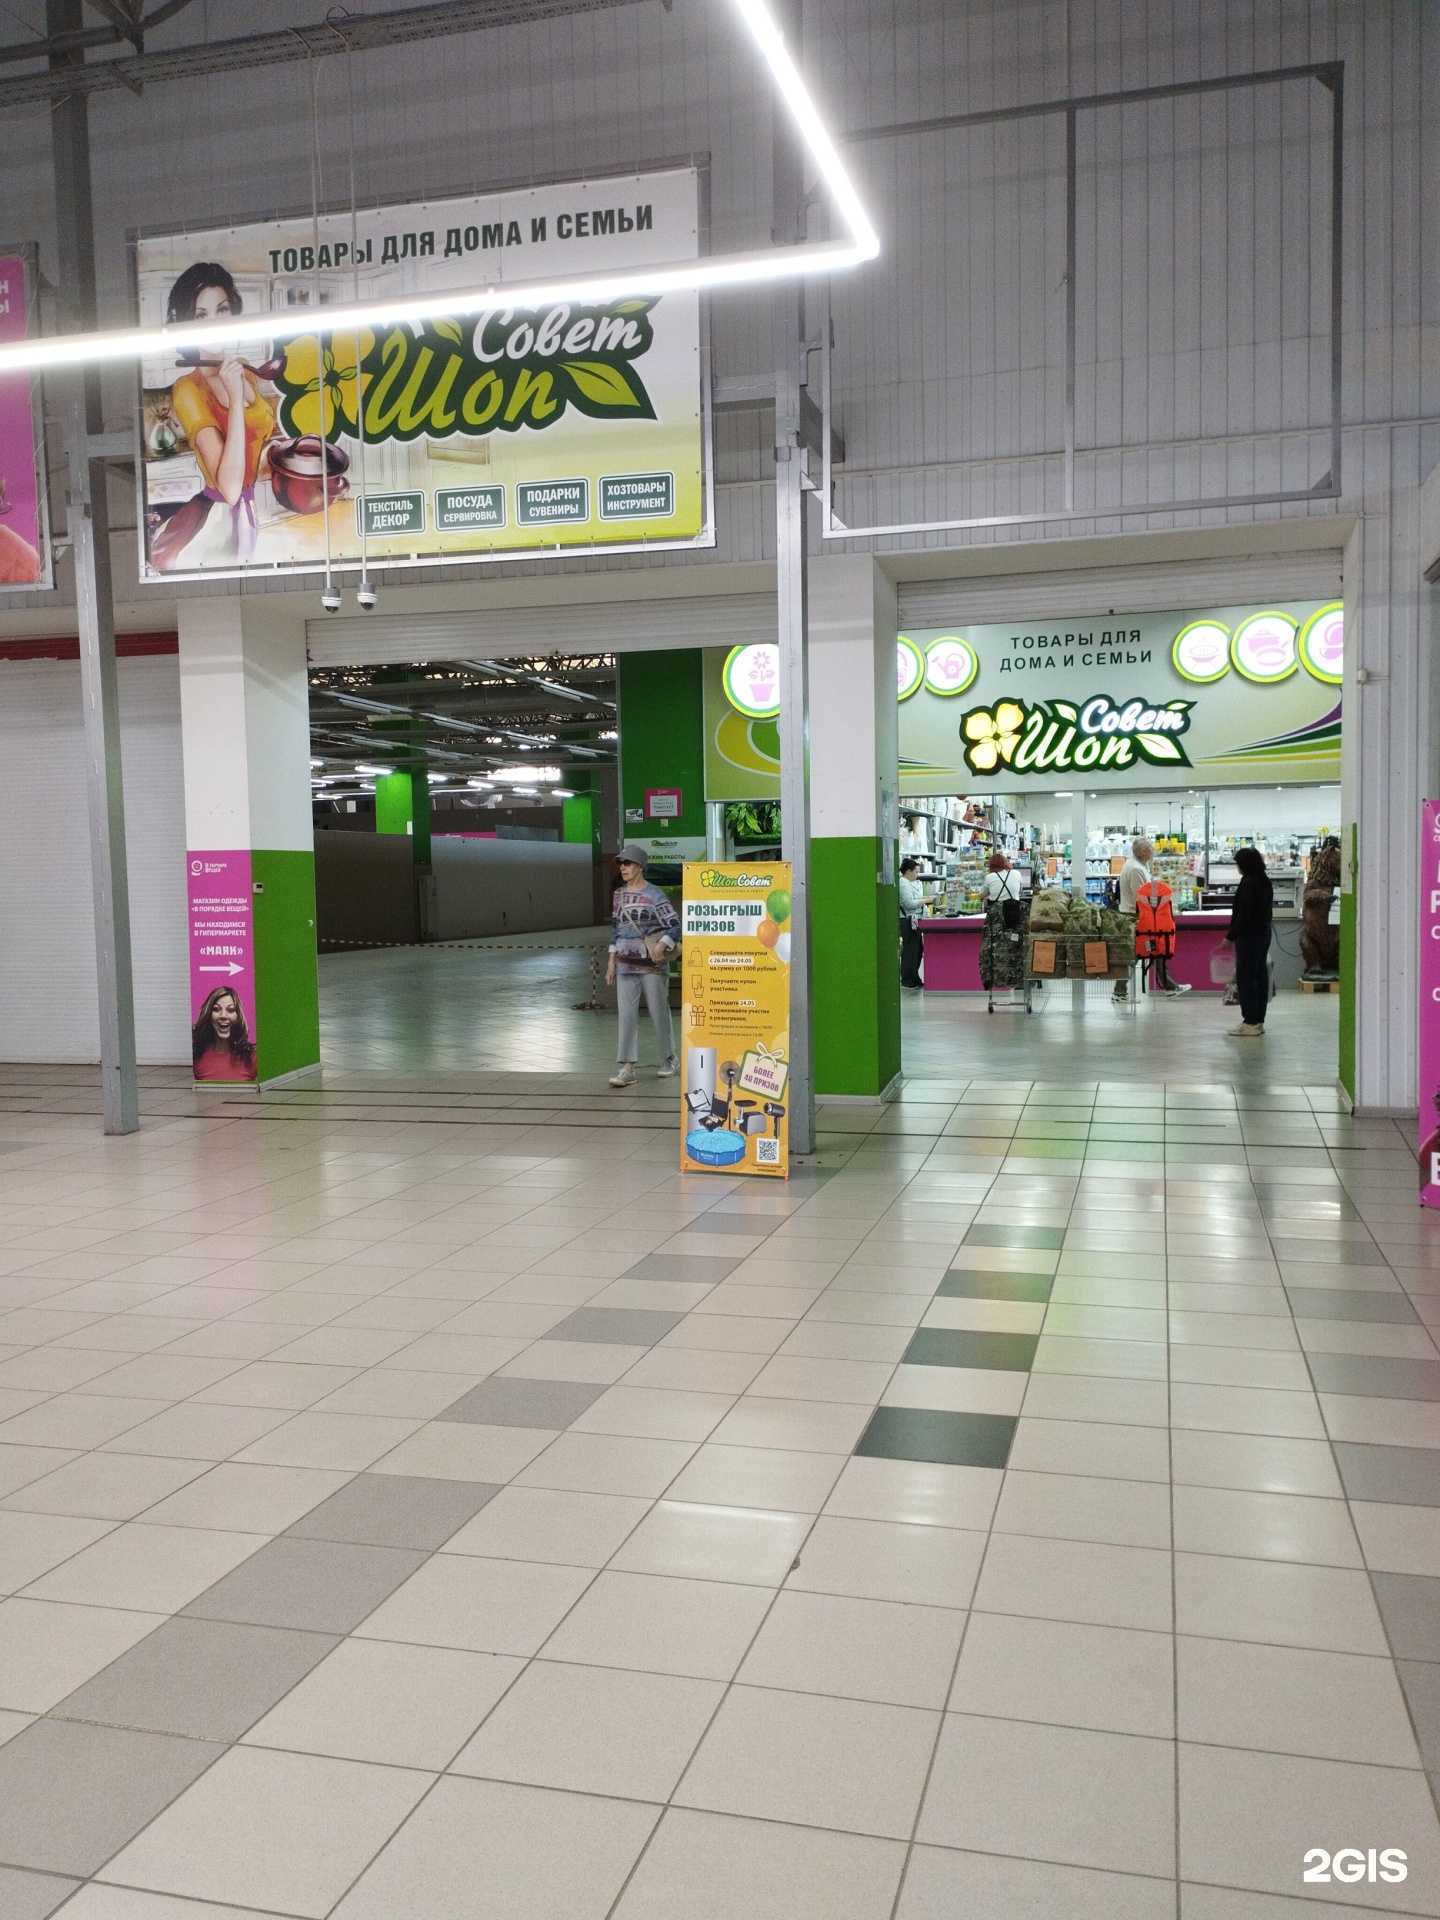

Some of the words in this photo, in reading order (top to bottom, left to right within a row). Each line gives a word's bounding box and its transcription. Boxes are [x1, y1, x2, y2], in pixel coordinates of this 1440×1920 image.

[269, 239, 372, 273] ТОВАРЫ
[381, 230, 435, 264] ДЛЯ
[444, 220, 522, 257] ДОМА
[531, 216, 547, 242] И
[556, 204, 653, 239] СЕМЬИ
[473, 304, 642, 363] Совет
[365, 326, 557, 435] Шоп
[527, 487, 580, 503] ПОДАРКИ
[607, 482, 666, 496] ХОЗТОВАРЫ
[367, 501, 413, 514] ТЕКСТИЛЬ
[447, 495, 493, 509] ПОСУДА
[607, 497, 666, 511] ИНСТРУМЕНТ
[444, 509, 497, 523] СЕРВИРОВКА
[529, 503, 579, 517] СУВЕНИРЫ
[372, 512, 410, 529] ДЕКОР
[1011, 633, 1093, 650] ТОВАРЫ
[1100, 630, 1141, 647] ДЛЯ
[1000, 655, 1056, 672] ДОМА
[1063, 655, 1074, 667] И
[1082, 650, 1151, 666] СЕМЬИ
[1080, 698, 1184, 734] Совет
[1015, 710, 1133, 768] Шоп
[687, 904, 762, 916] РОЗЫГРЫШ
[687, 920, 735, 932] ПРИЗОВ
[200, 946, 243, 955] «МАЯК»
[753, 1077, 779, 1092] ПРИЗОВ
